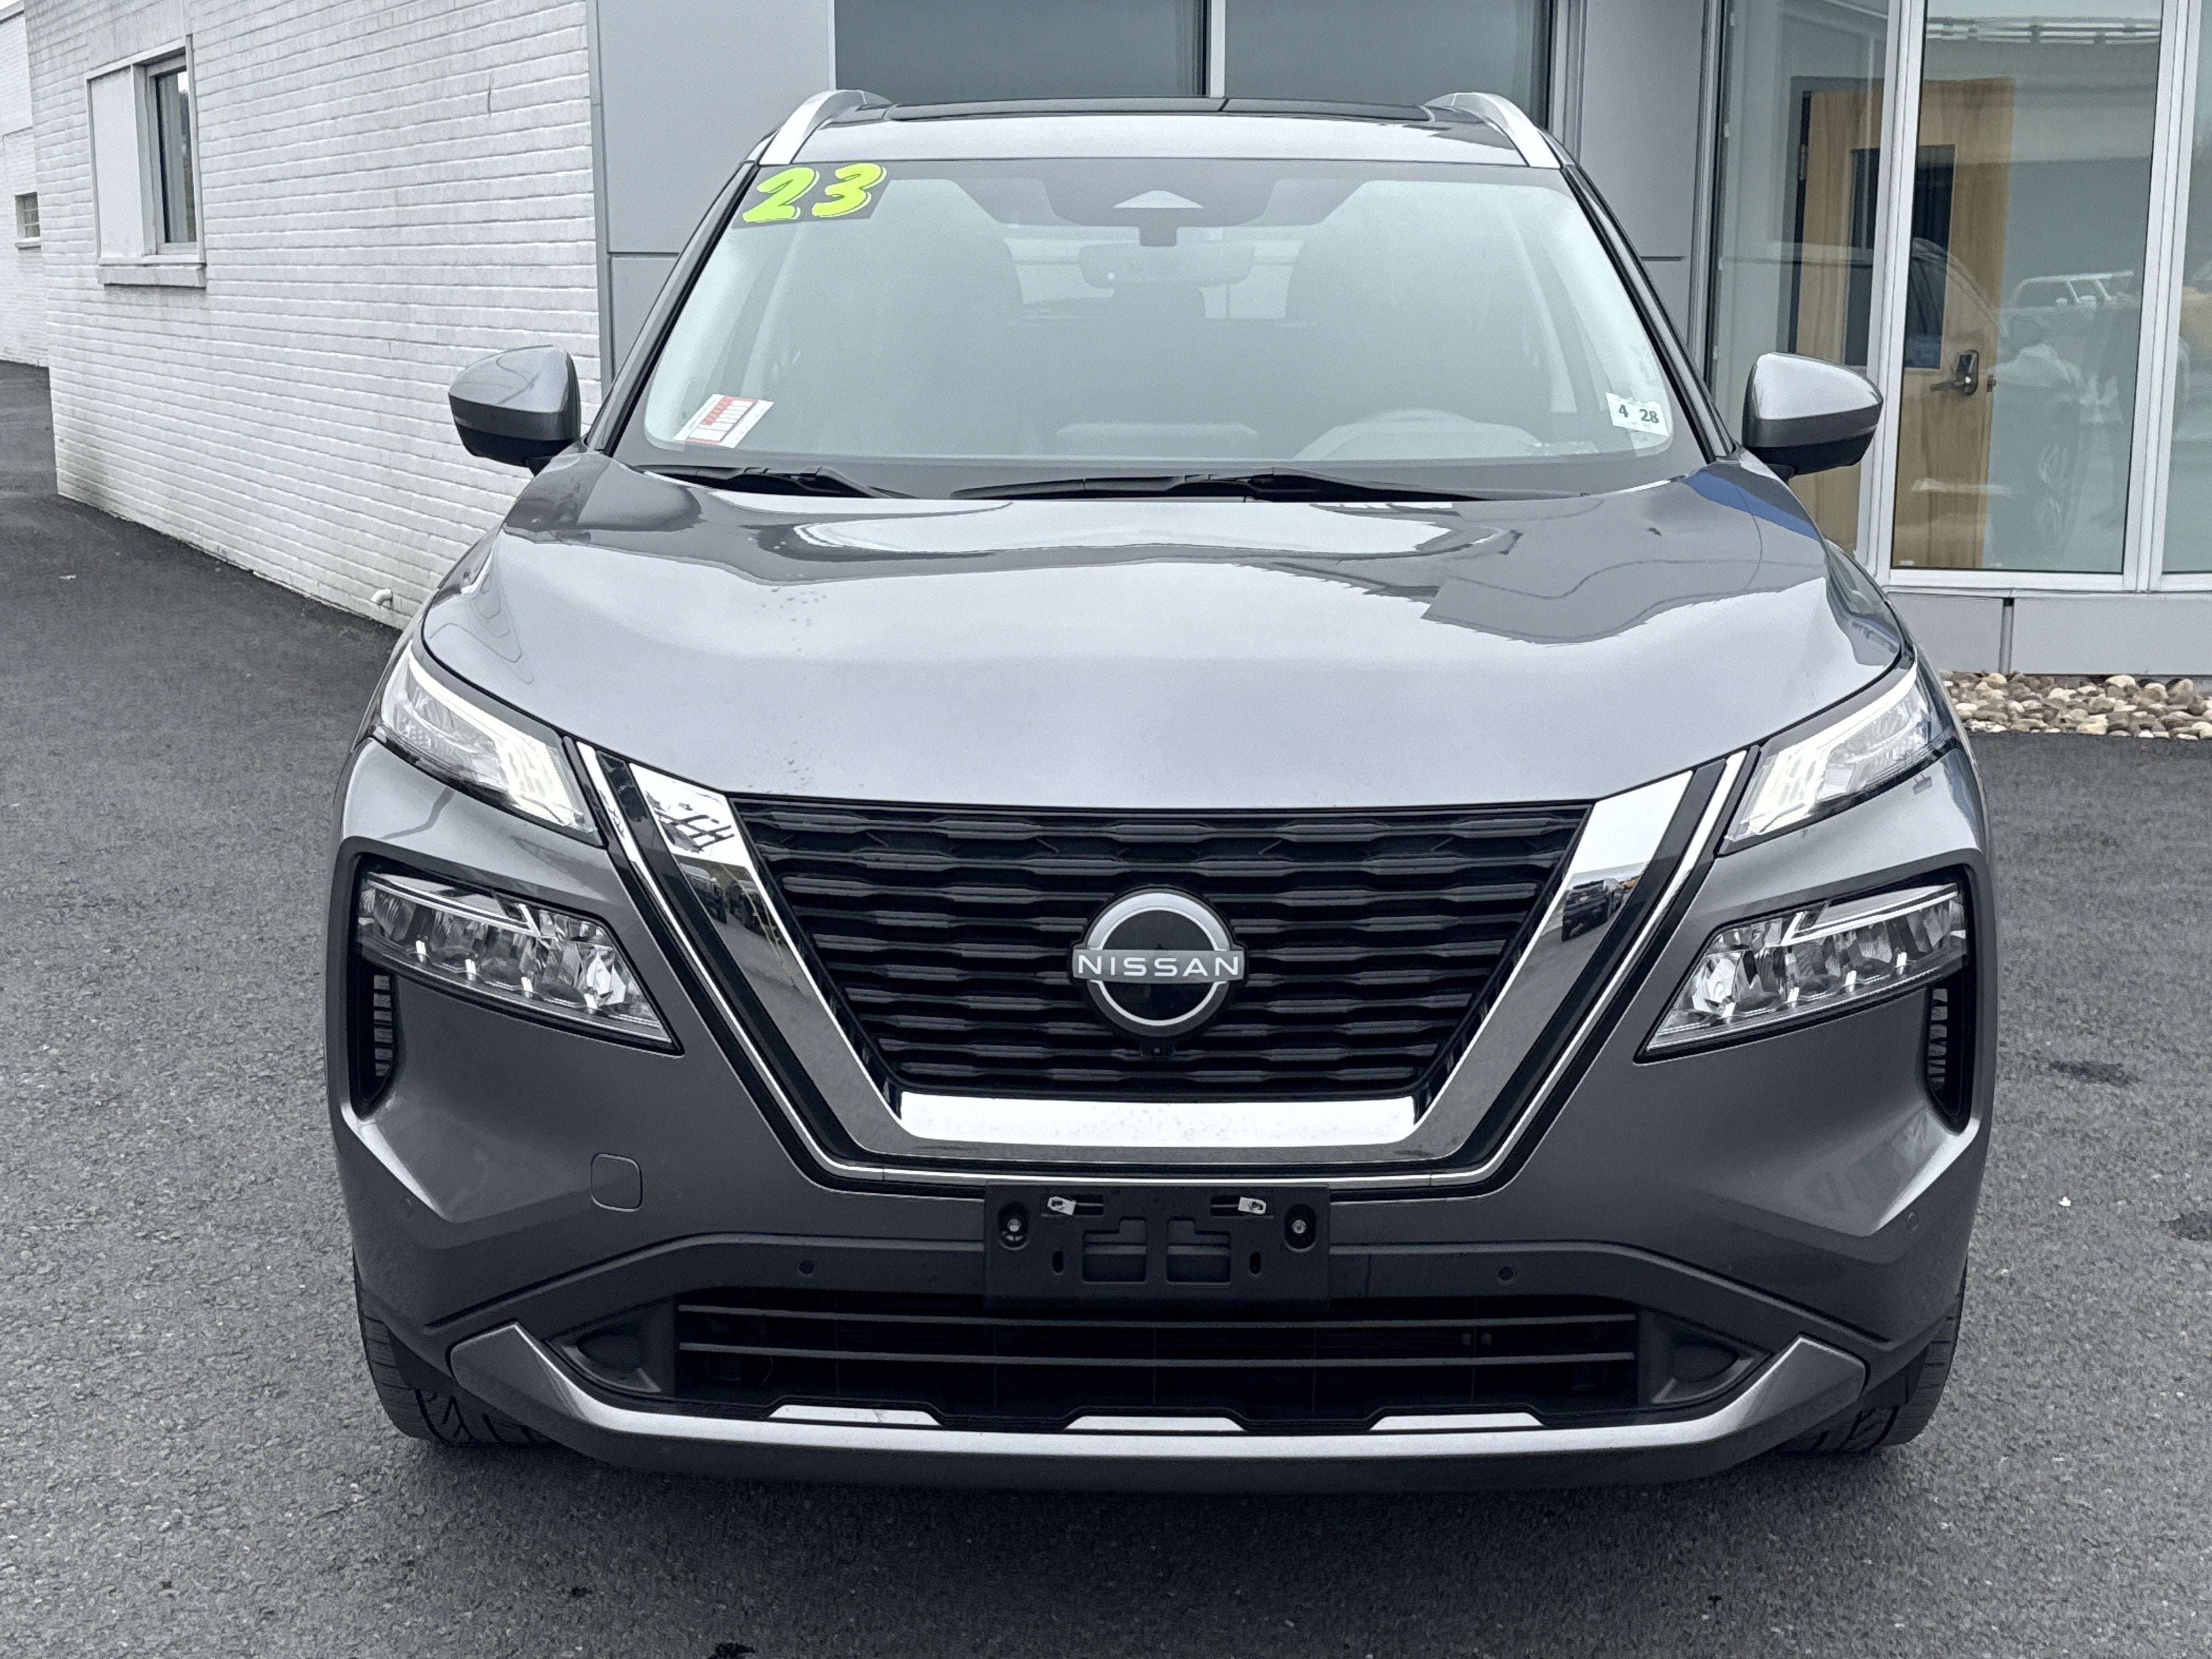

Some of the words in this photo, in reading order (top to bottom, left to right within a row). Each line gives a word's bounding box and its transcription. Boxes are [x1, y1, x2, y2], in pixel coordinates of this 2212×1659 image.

[742, 163, 887, 222] 23
[1618, 404, 1629, 418] 4
[1639, 409, 1660, 424] 28
[1078, 955, 1238, 977] NISSAN
